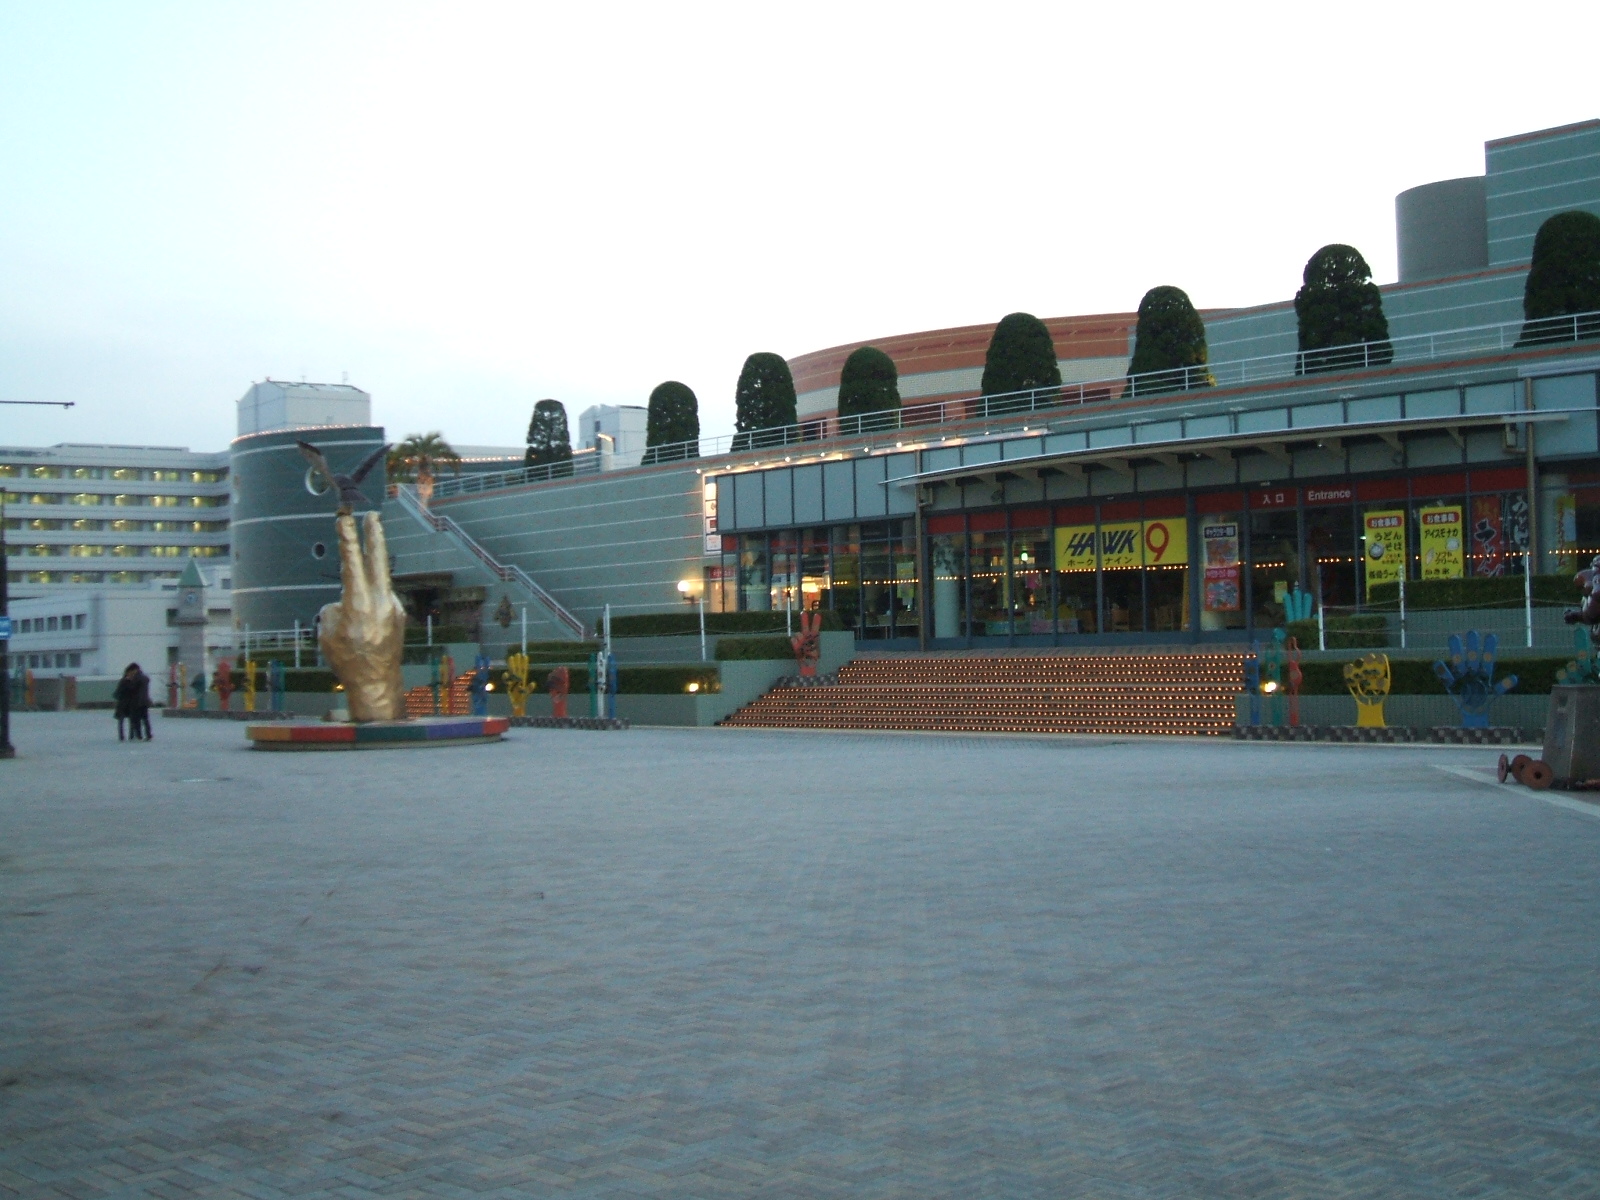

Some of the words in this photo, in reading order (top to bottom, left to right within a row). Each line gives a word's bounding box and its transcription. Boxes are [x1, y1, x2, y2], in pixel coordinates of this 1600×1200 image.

[1308, 489, 1351, 502] Entrance
[1063, 530, 1140, 557] HAWK
[1146, 522, 1170, 563] 9
[1374, 530, 1402, 542] うどん
[1068, 558, 1094, 568] ホーク
[1104, 555, 1133, 566] ナイン
